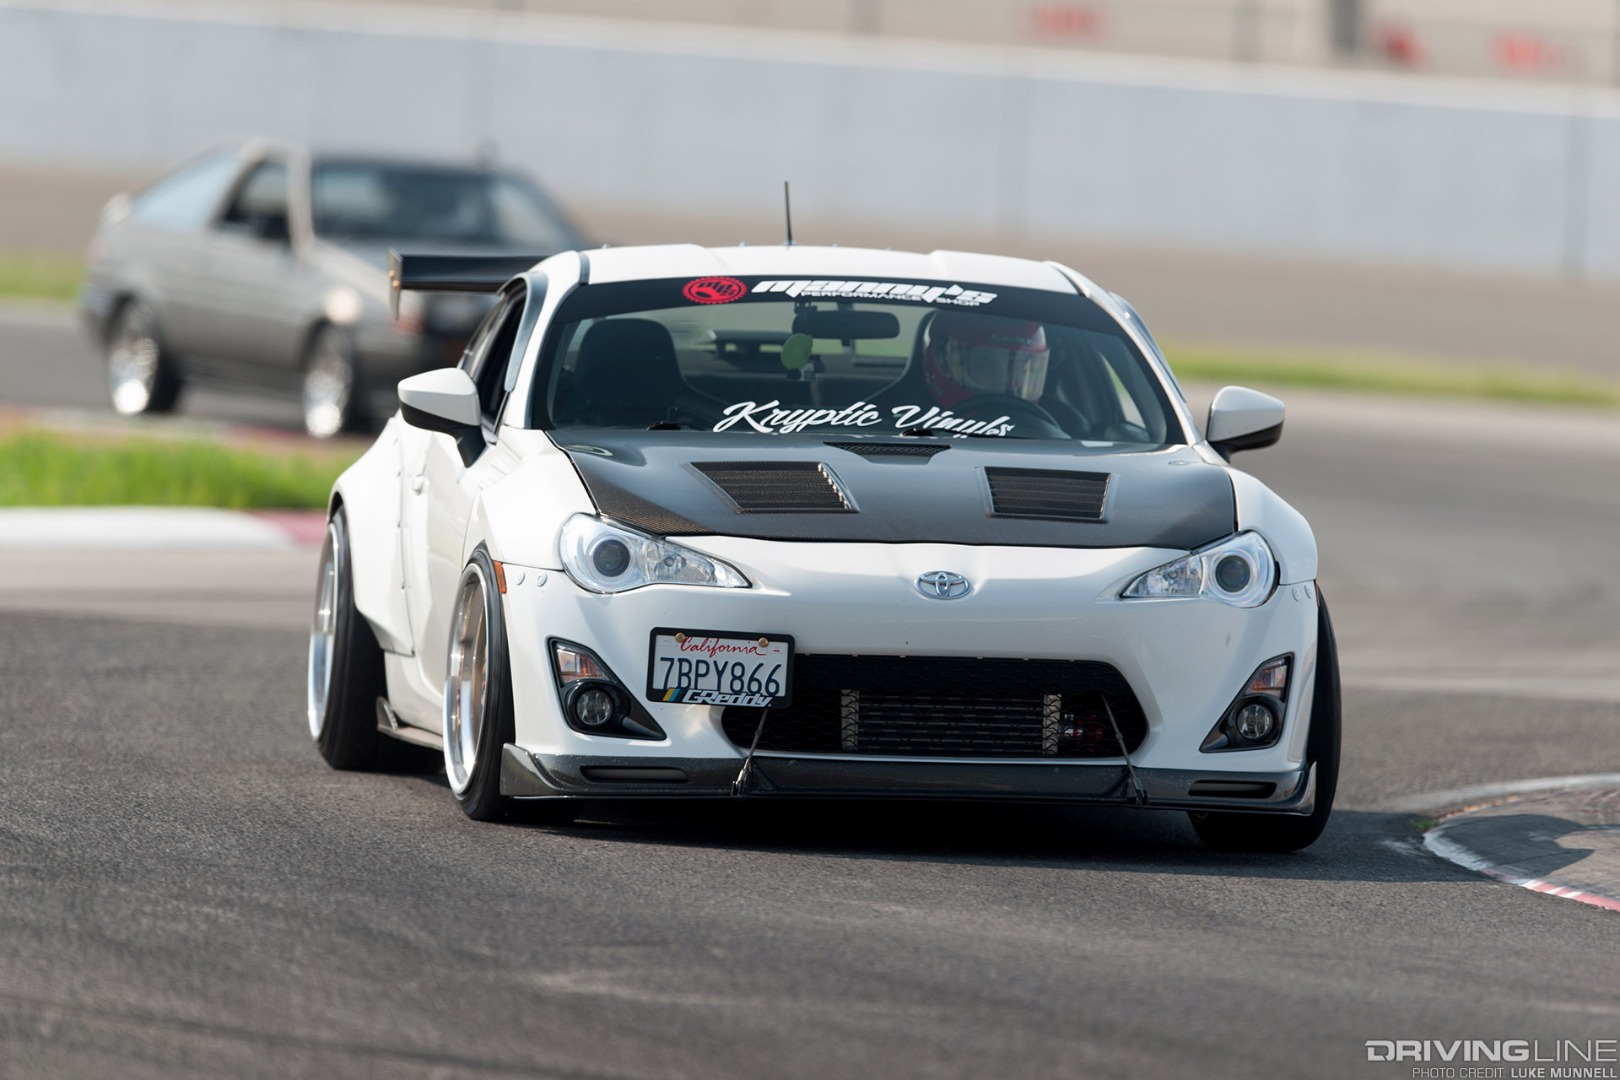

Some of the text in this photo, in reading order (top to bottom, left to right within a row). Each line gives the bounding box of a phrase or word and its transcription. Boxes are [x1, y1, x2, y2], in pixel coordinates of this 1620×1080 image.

[712, 400, 883, 434] Kryptic
[680, 637, 767, 658] California
[660, 656, 782, 696] 7BPY866
